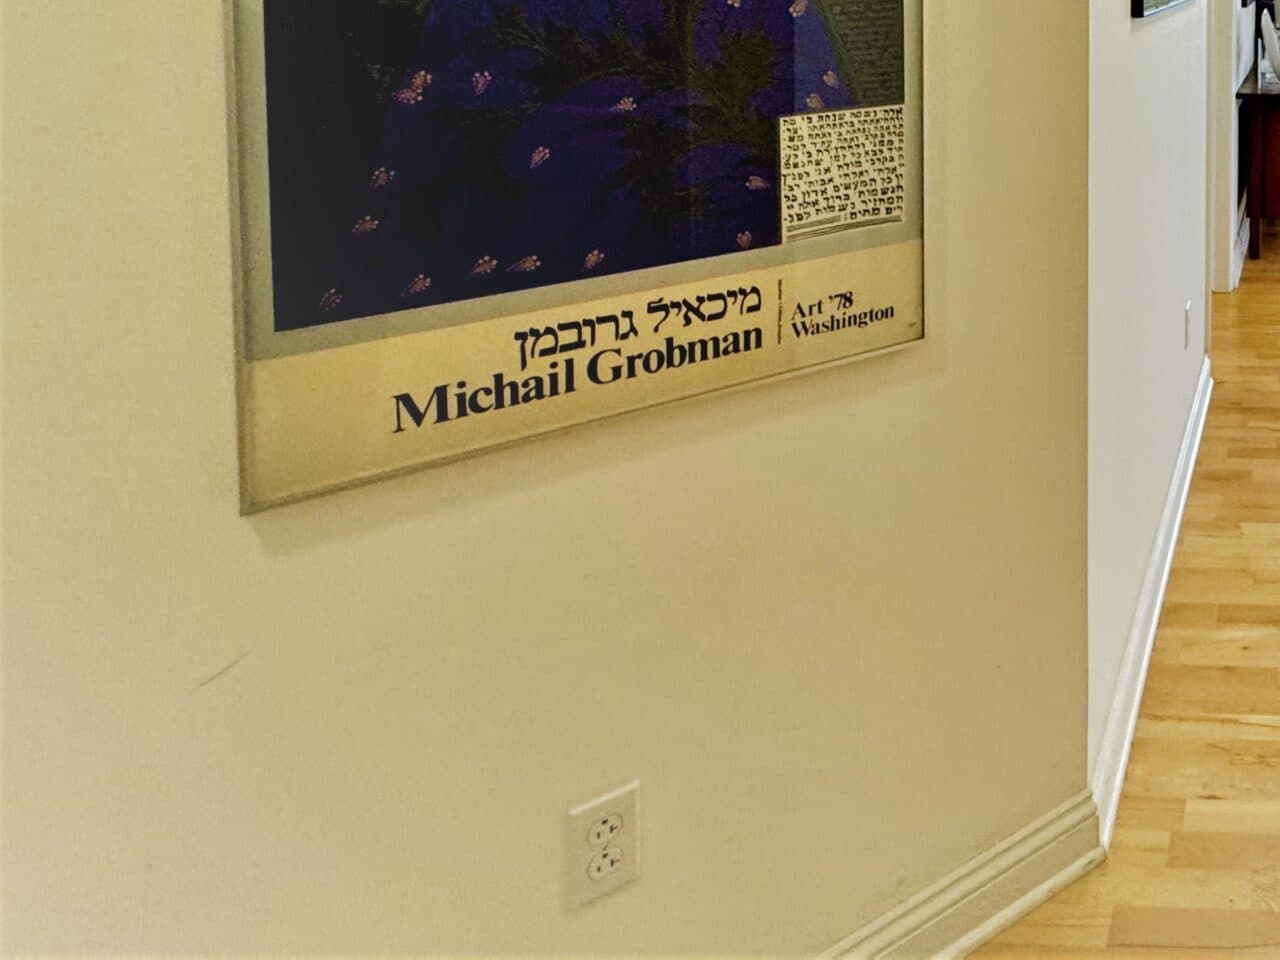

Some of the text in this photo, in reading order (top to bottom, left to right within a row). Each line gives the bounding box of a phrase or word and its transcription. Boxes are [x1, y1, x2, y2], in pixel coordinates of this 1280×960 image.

[647, 286, 762, 333] מיכאיל
[791, 299, 825, 320] Art
[791, 305, 895, 339] Washington
[514, 309, 639, 371] גרובמן
[392, 326, 763, 434] Michail Grobman
